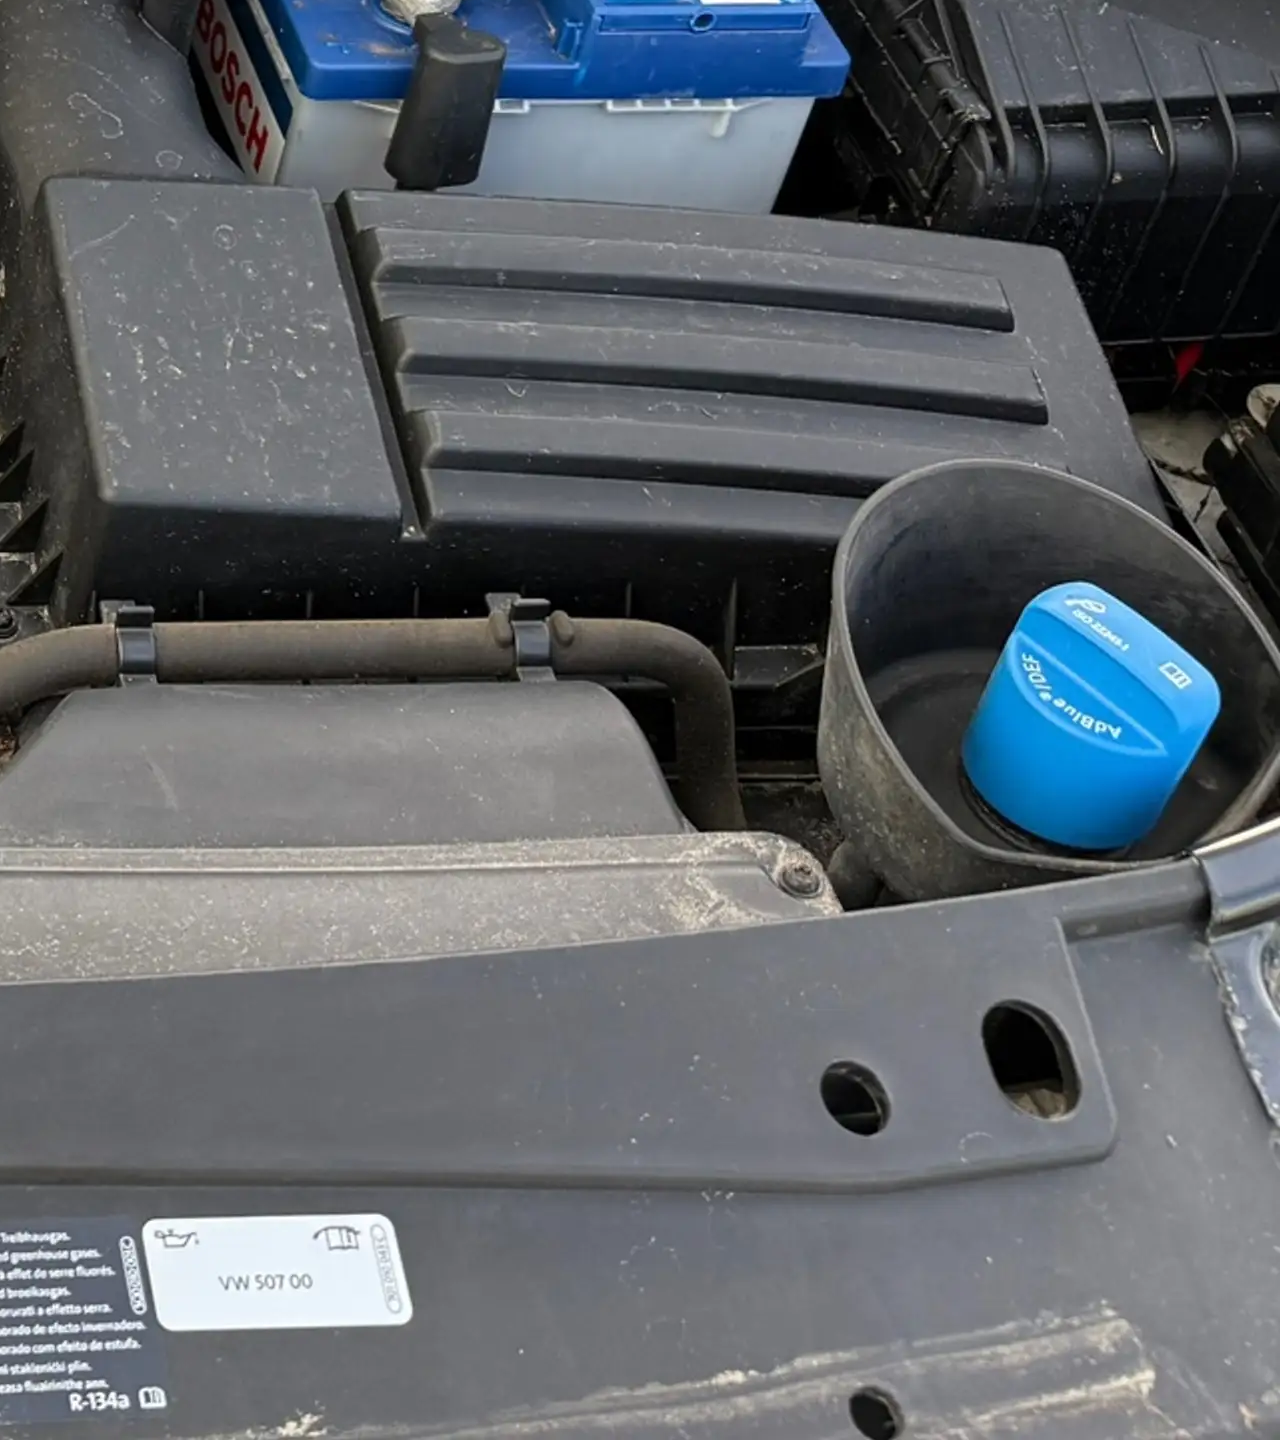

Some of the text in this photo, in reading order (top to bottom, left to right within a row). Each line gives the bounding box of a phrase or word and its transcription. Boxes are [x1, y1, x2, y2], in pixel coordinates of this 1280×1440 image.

[10, 1249, 69, 1265] greenhouse
[6, 1267, 32, 1281] effet
[34, 1268, 47, 1279] de
[218, 1273, 314, 1291] VW 507 00
[32, 1323, 46, 1334] de
[32, 1344, 55, 1354] com
[90, 1341, 103, 1352] de
[69, 1392, 130, 1411] R-134a
